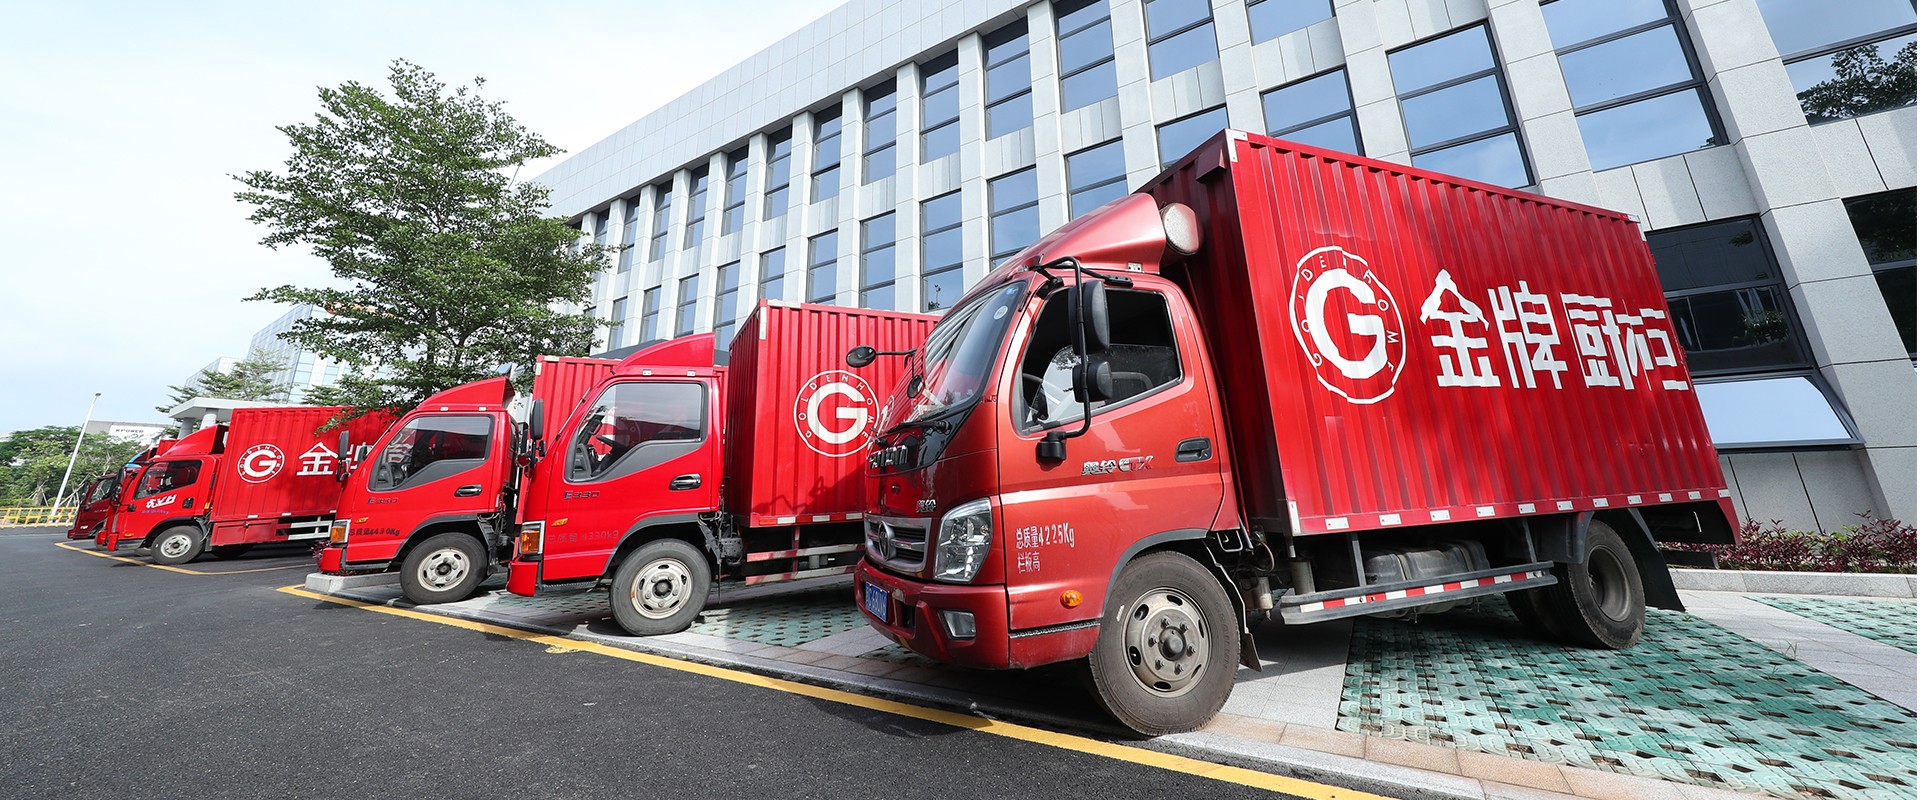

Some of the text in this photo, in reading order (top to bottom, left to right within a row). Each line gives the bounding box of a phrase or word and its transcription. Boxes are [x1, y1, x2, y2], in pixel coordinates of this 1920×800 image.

[1305, 268, 1388, 379] G
[798, 374, 875, 439] GOLDENHOME
[807, 382, 868, 444] G
[243, 450, 277, 477] G
[1118, 455, 1154, 472] CTX
